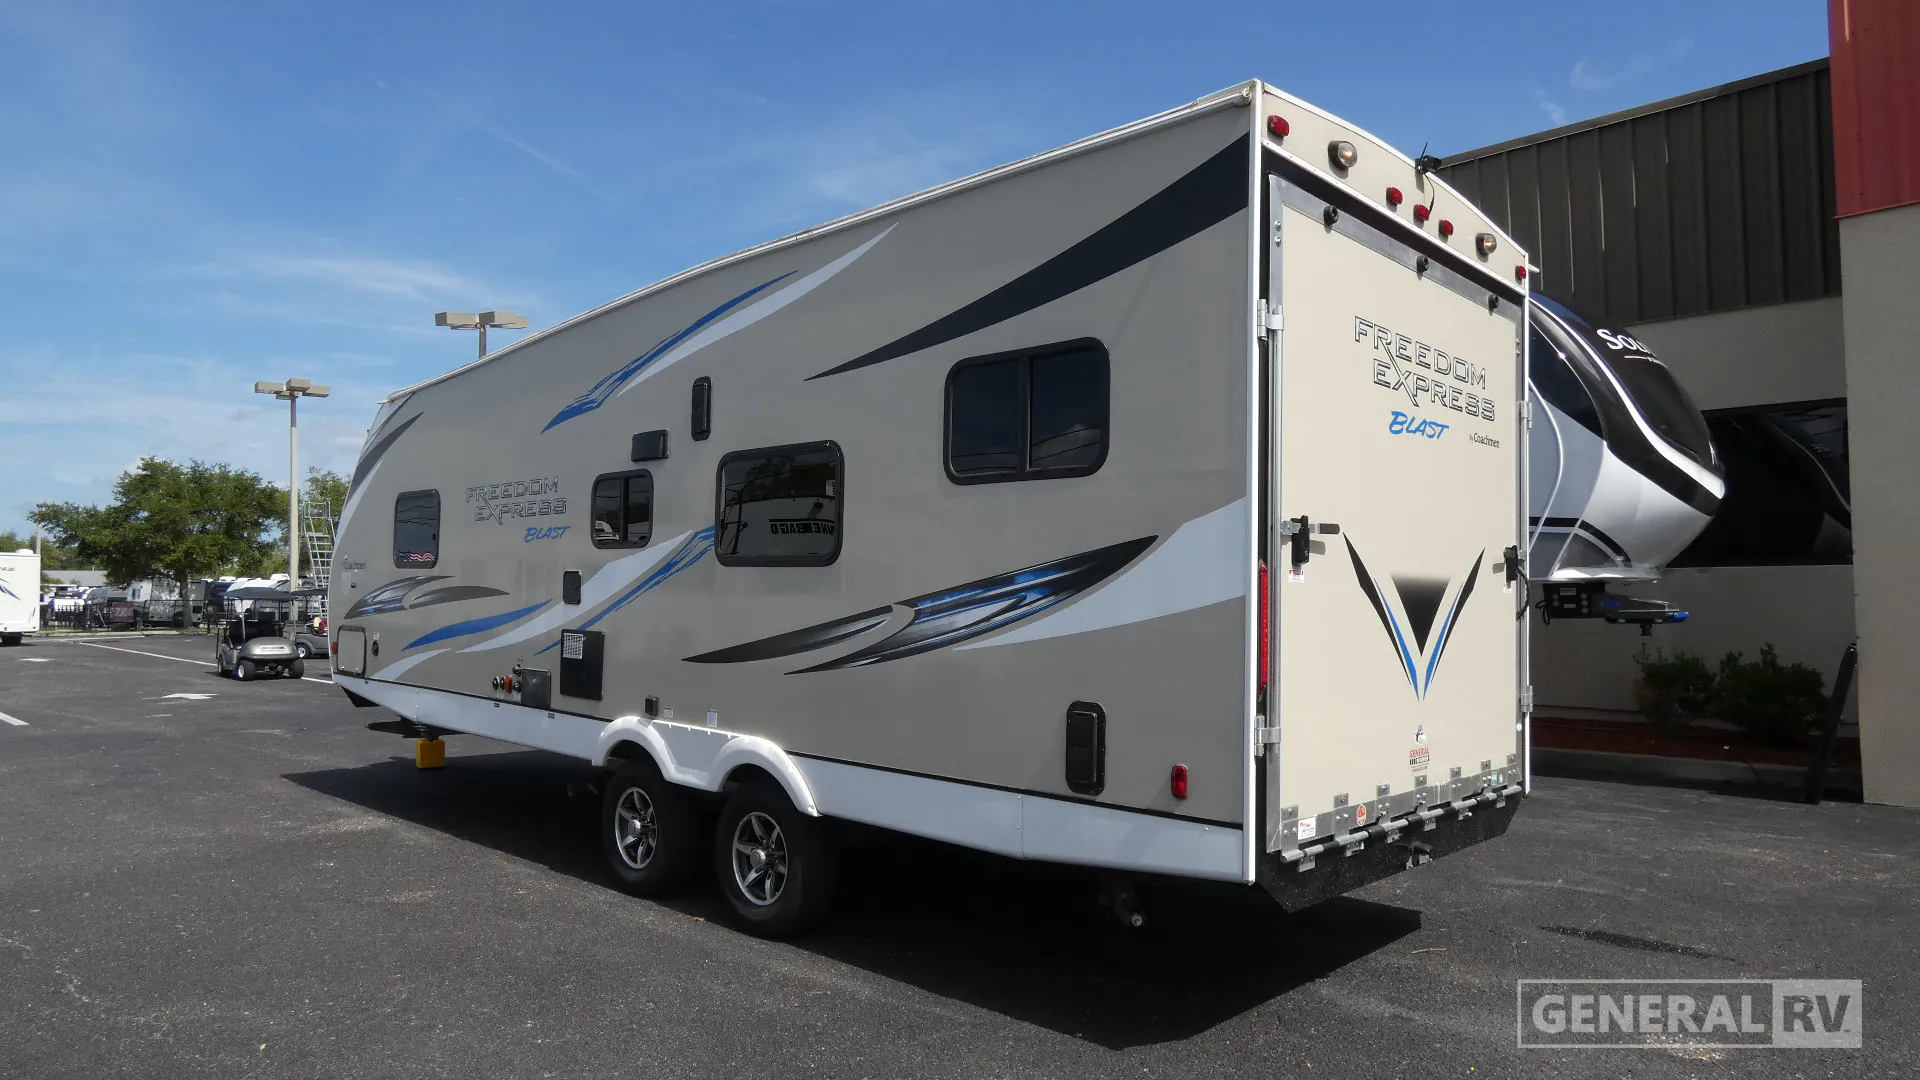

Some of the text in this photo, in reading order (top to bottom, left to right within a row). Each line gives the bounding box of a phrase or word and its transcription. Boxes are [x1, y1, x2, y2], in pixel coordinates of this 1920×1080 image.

[1354, 315, 1486, 390] FREEDOM
[1373, 358, 1496, 422] EXPRESS
[1388, 410, 1450, 440] BLAST
[1474, 432, 1501, 449] Coachmen
[465, 476, 559, 503] FREEDOM
[474, 498, 567, 525] EXPRESS
[524, 525, 571, 543] BLAST
